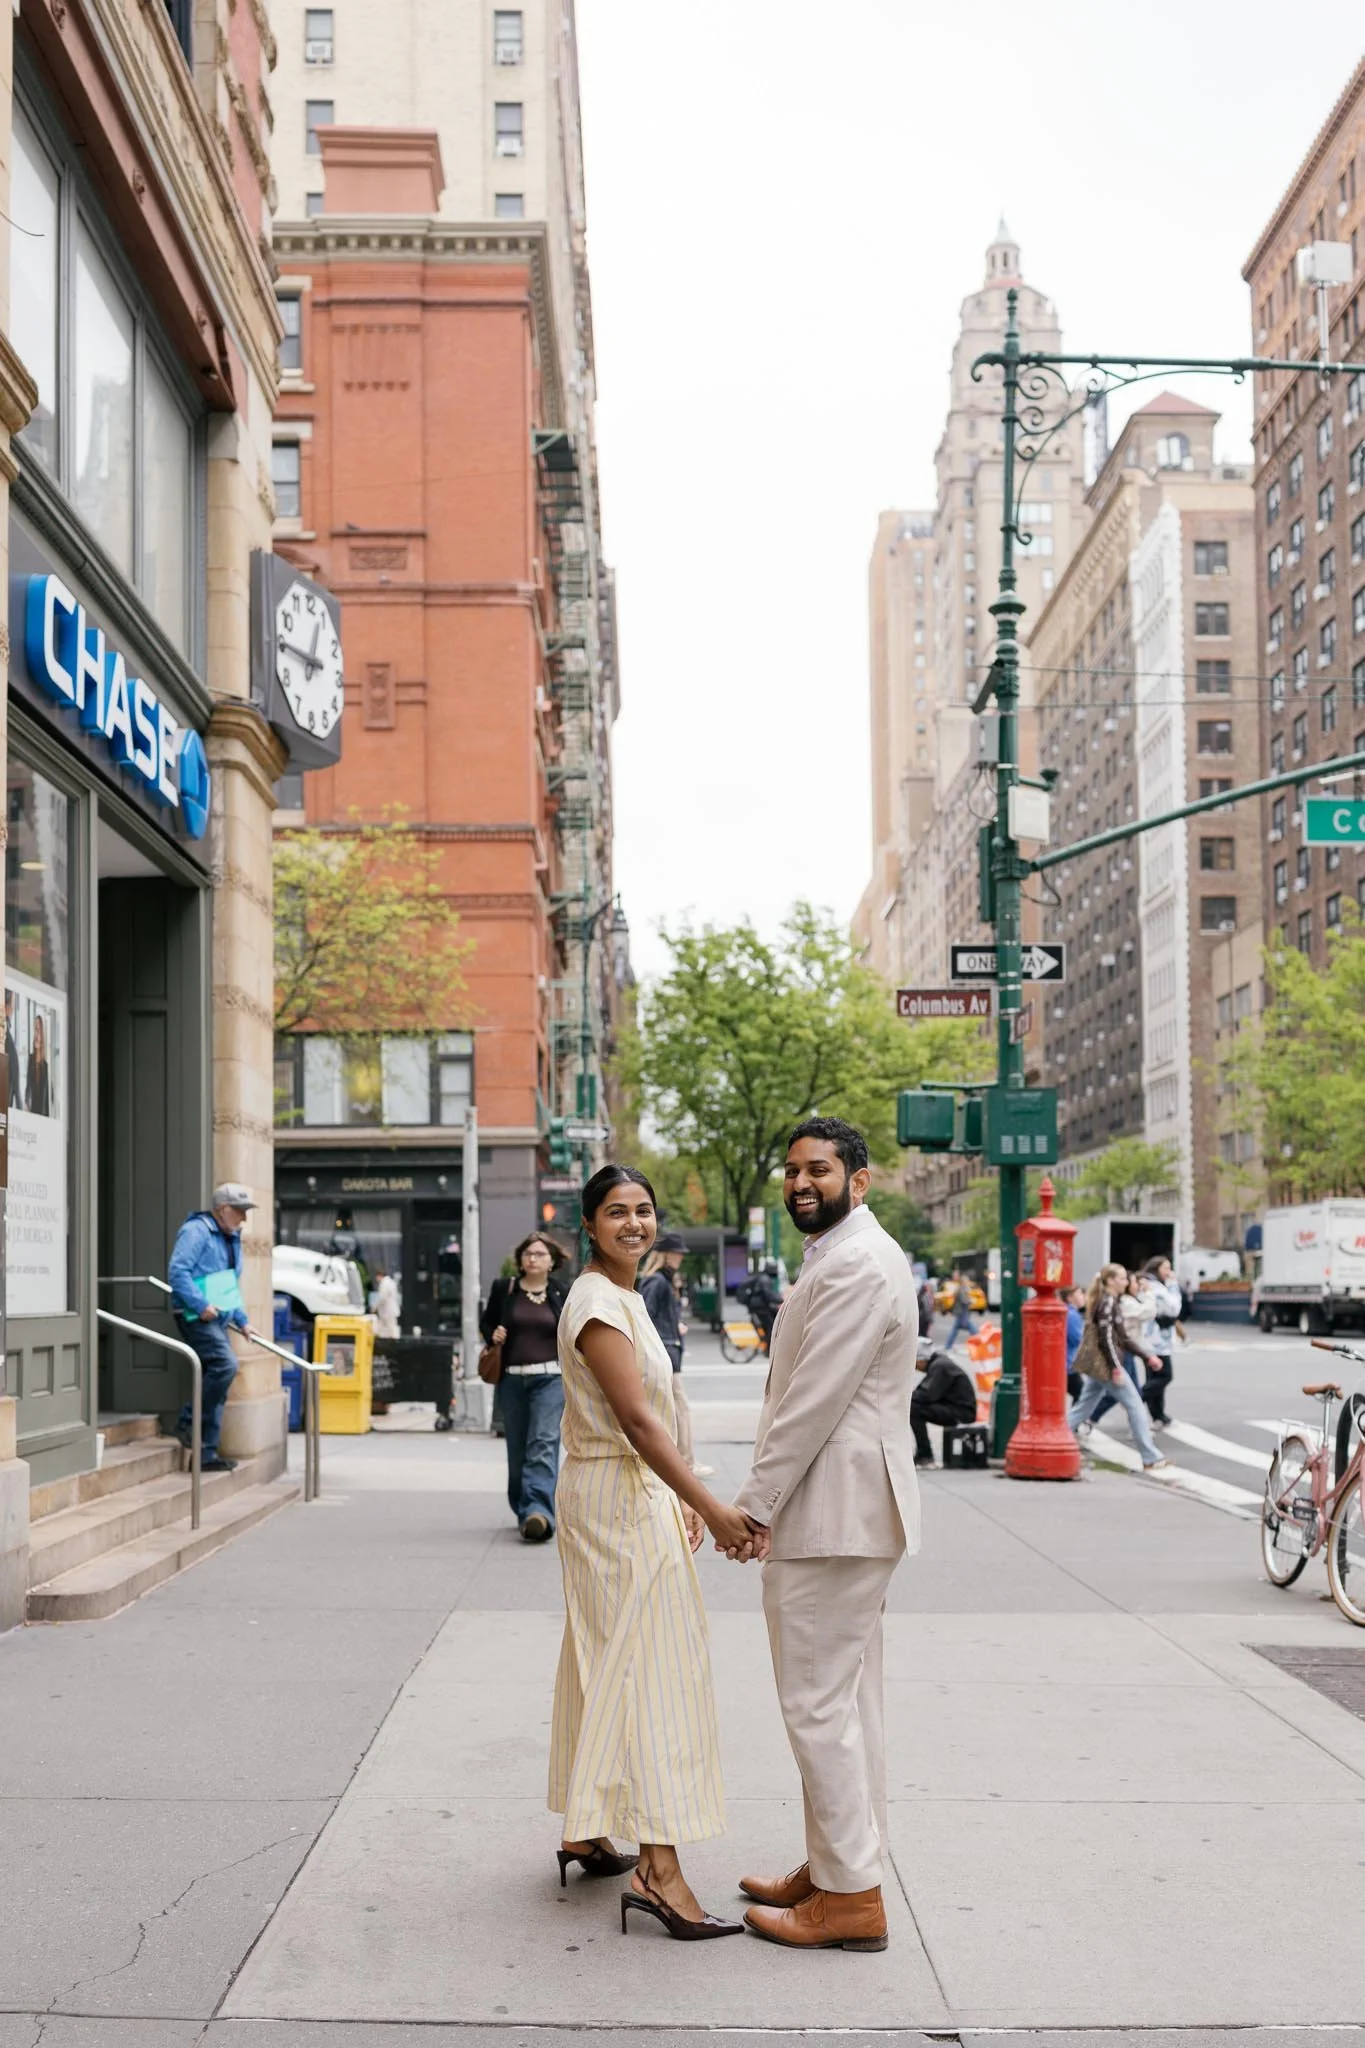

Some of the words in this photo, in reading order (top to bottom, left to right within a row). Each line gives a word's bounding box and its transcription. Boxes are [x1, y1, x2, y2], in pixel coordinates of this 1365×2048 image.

[292, 593, 301, 614] 11
[305, 593, 316, 616] 12
[282, 609, 293, 633] 10
[331, 640, 338, 660] 2
[283, 668, 290, 688] 8
[336, 670, 343, 689] 3
[27, 573, 180, 808] CHASE
[295, 695, 301, 714] 7
[331, 696, 338, 713] 4
[322, 710, 328, 729] 5
[967, 956, 997, 970] ONE
[900, 995, 965, 1015] Columbus
[970, 995, 988, 1015] Av
